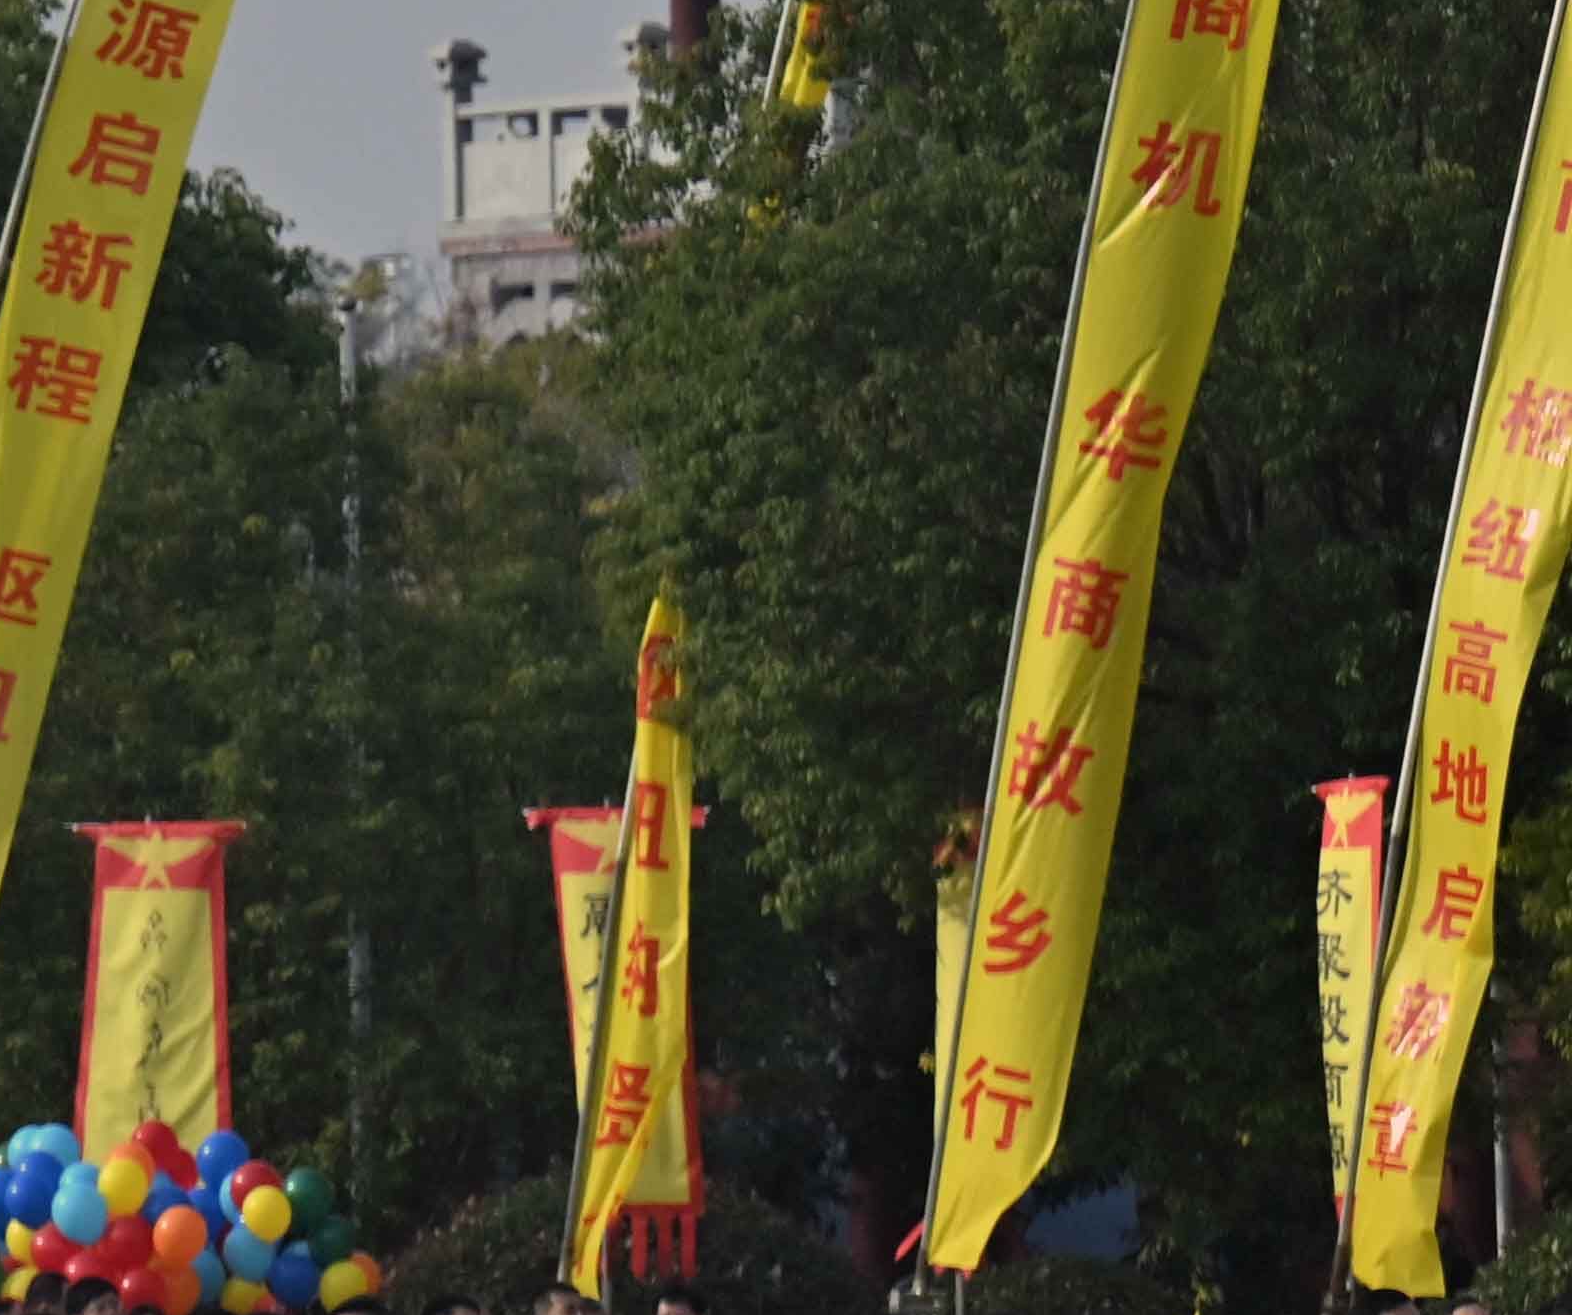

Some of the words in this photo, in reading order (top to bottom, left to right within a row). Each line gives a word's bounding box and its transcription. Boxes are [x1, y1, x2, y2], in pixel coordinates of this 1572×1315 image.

[961, 389, 1167, 1151] 华商故乡行
